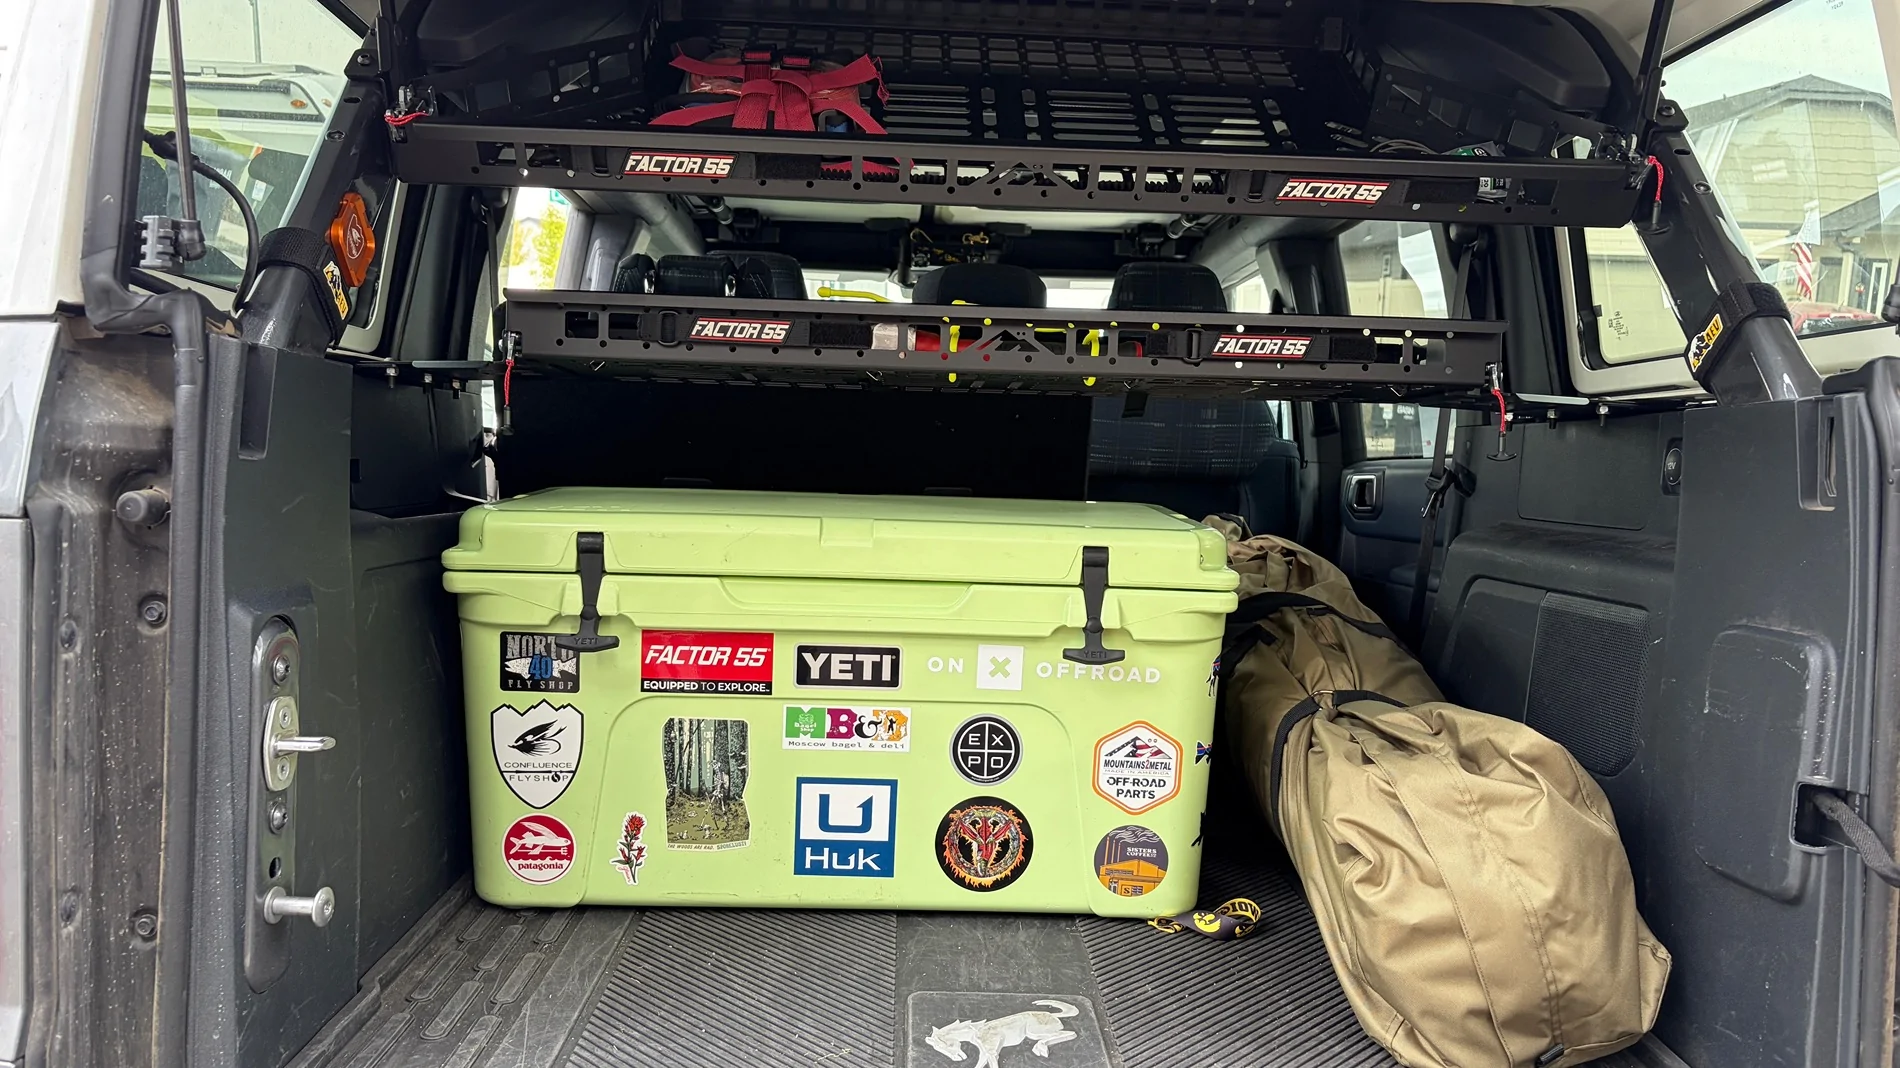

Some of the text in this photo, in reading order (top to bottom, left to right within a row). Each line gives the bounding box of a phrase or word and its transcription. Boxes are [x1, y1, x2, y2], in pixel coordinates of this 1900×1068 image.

[625, 155, 734, 175] FACTOR 55
[1278, 182, 1388, 201] FACTOR 55
[691, 320, 790, 340] FACTOR 55
[1706, 319, 1720, 342] AEV
[1213, 337, 1310, 355] FACTOR 55
[573, 637, 599, 645] YETI
[644, 644, 768, 667] FACTOR 55
[1083, 650, 1107, 659] YETI
[529, 654, 553, 680] 40
[801, 652, 892, 681] YETI
[927, 656, 964, 674] ON
[1036, 661, 1161, 683] OFFROAD
[508, 680, 574, 690] FLY SHOP
[643, 680, 699, 690] EQUIPPED
[700, 682, 716, 691] TO
[788, 740, 826, 748] Moscow
[831, 741, 862, 750] bagel
[880, 743, 905, 751] deli
[504, 761, 573, 769] CONFLUENCE
[1103, 758, 1172, 771] MOUNTAINS2METAL
[1106, 776, 1167, 788] OFF-ROAD
[1116, 788, 1156, 800] PARTS
[517, 861, 564, 871] patagonia
[805, 846, 881, 871] Huk
